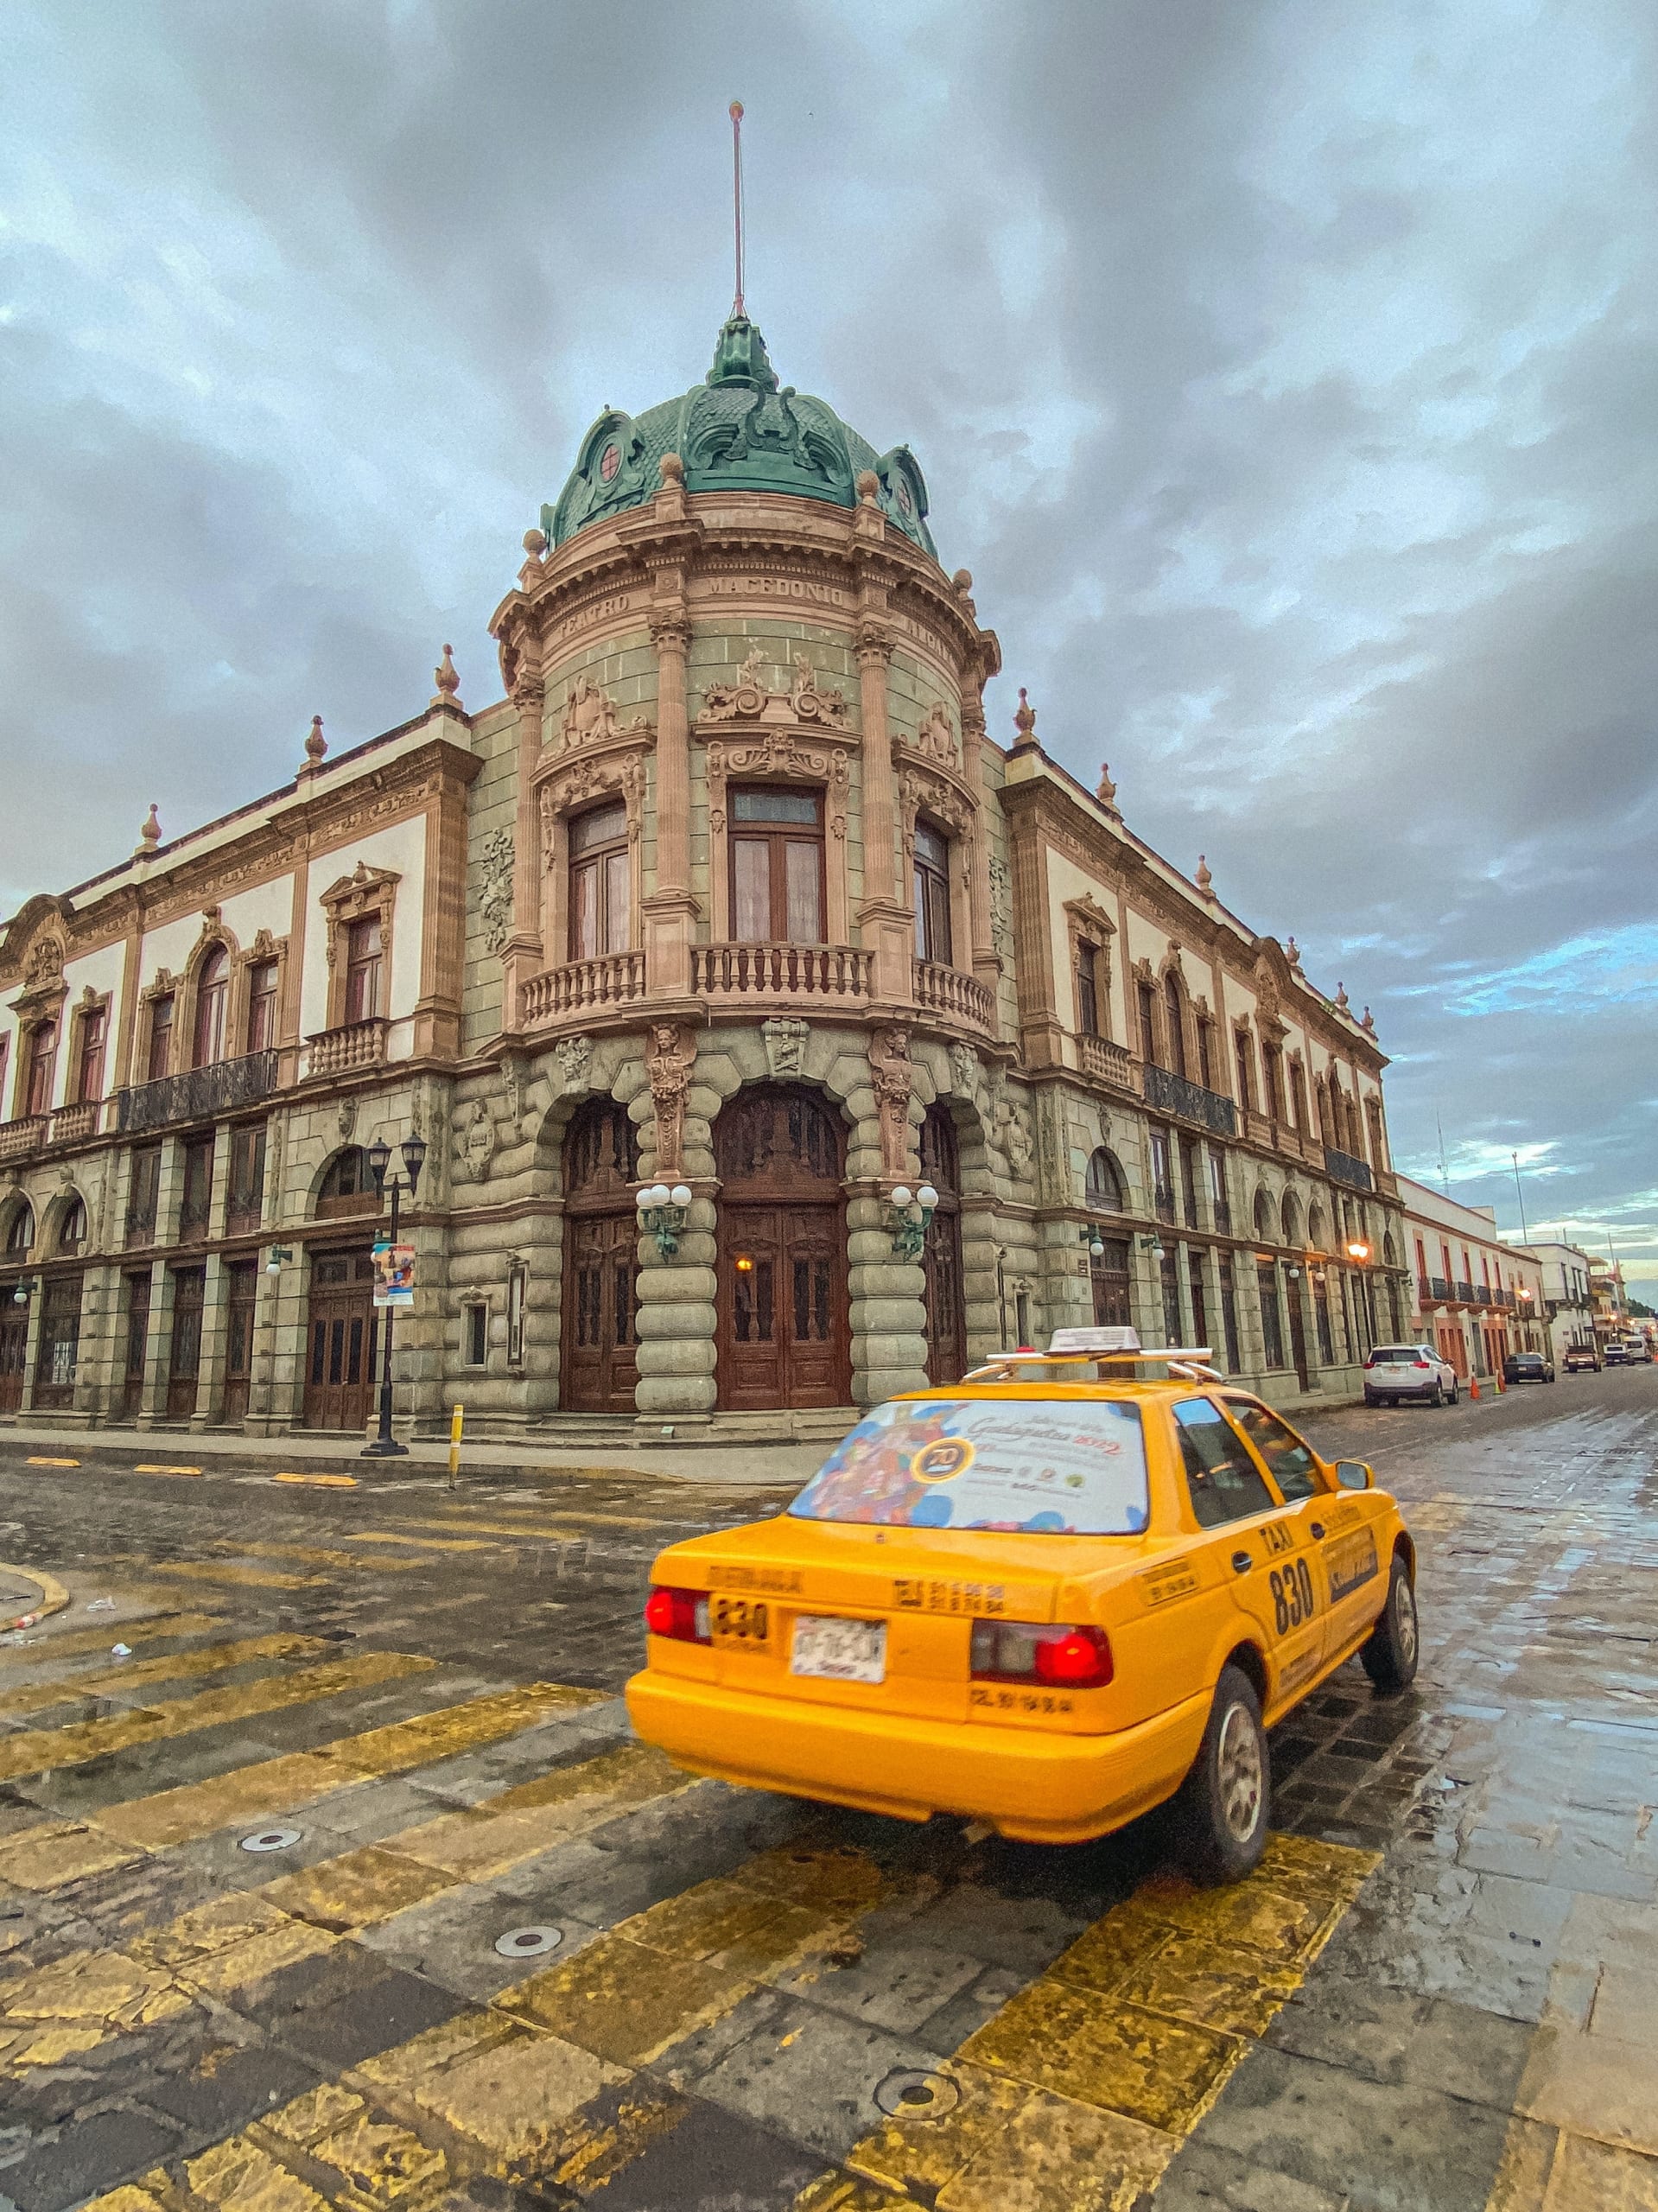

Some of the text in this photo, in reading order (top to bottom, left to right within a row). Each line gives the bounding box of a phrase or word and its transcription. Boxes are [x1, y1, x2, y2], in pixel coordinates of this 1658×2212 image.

[556, 594, 629, 638] TEATRO
[709, 575, 843, 606] MACEDONIO
[1269, 1557, 1314, 1636] 830
